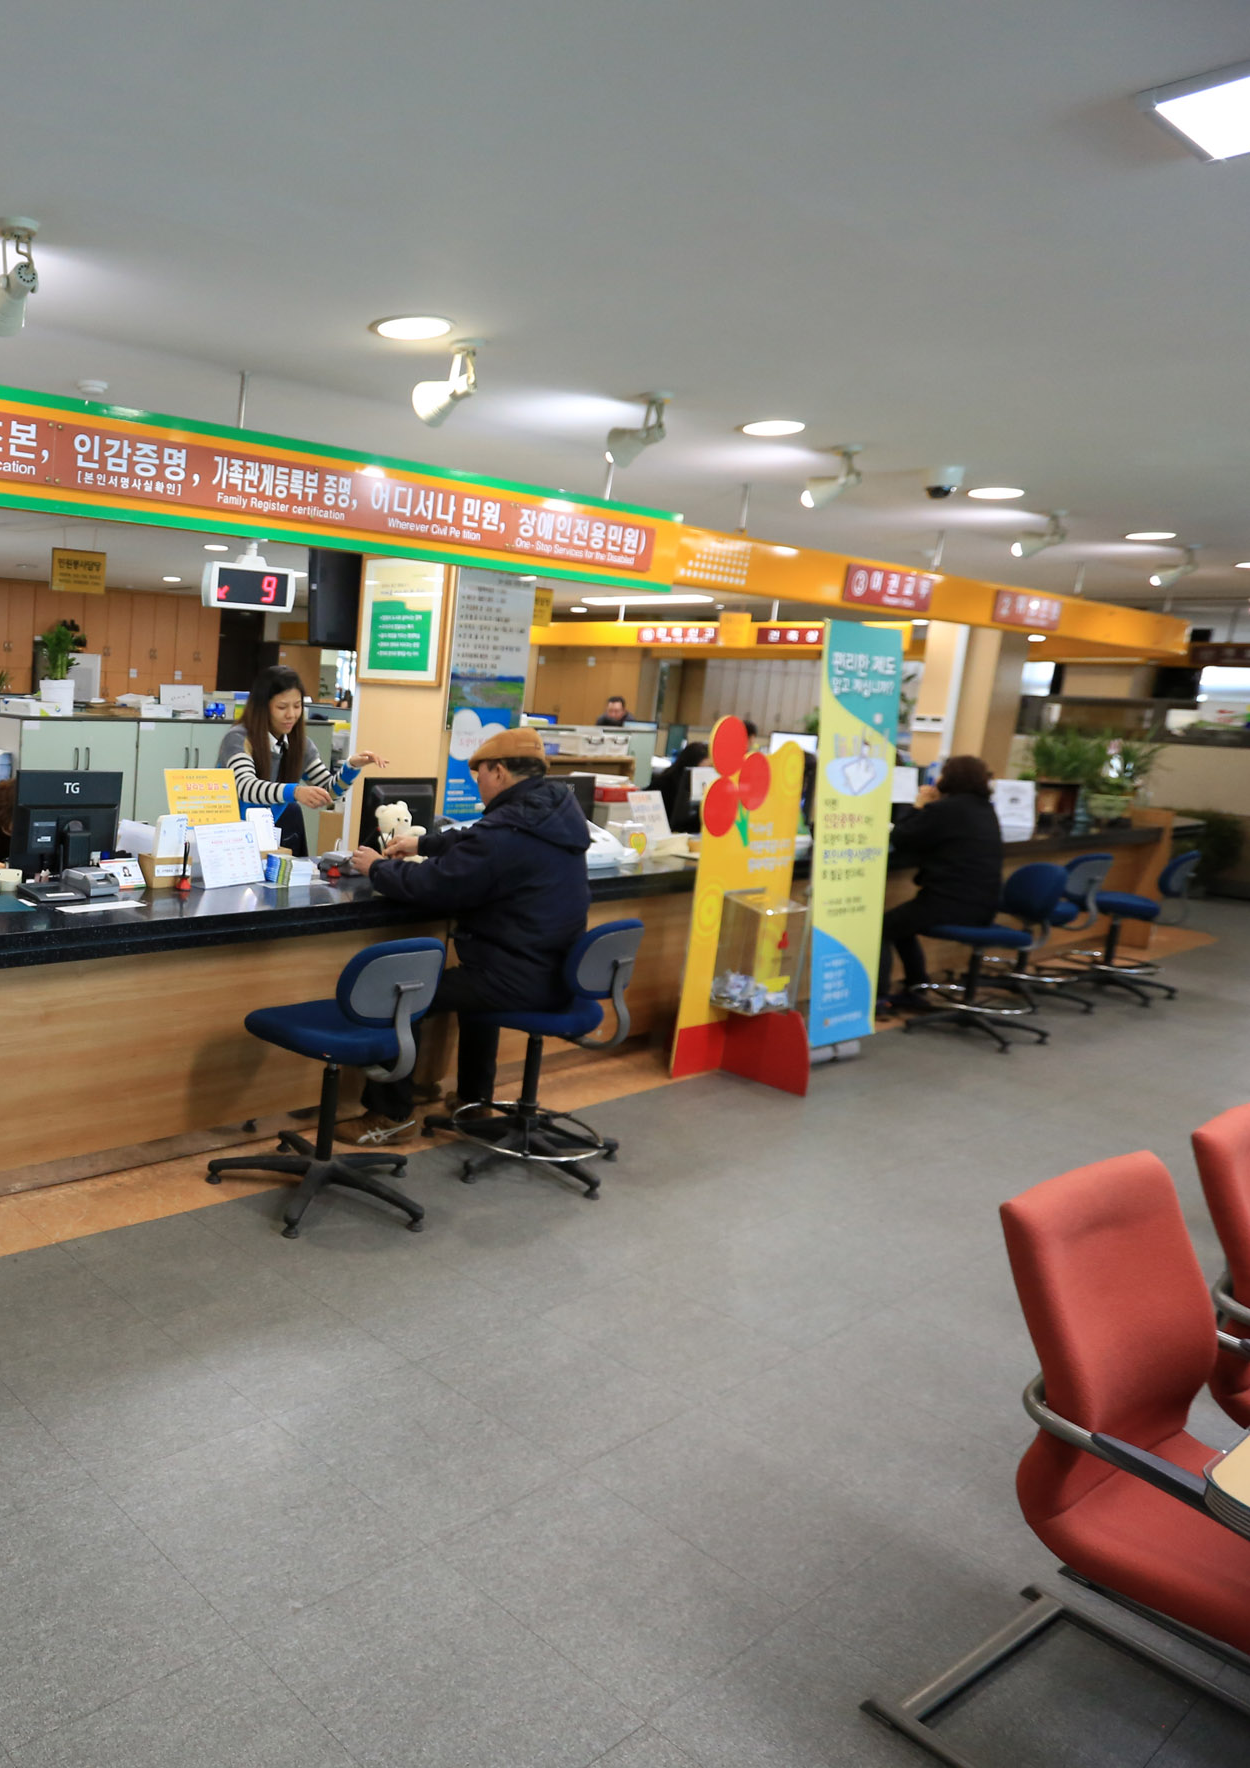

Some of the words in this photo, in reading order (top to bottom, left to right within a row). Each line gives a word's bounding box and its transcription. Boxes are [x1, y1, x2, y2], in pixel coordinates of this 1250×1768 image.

[73, 433, 200, 487] 인감증명,
[212, 454, 319, 503] 가족관계등록부
[323, 473, 358, 510] 증명,
[371, 481, 456, 524] 어디서나
[462, 497, 505, 534] 민원,
[518, 508, 646, 555] 장애인전용민원)
[217, 492, 247, 509] Family
[250, 497, 289, 514] Register
[292, 504, 345, 520] certification
[388, 517, 429, 533] Wherever
[431, 523, 448, 536] Civil
[554, 544, 583, 557] Services
[585, 548, 594, 559] for
[595, 550, 606, 561] the
[607, 552, 635, 566] Disabled
[260, 575, 278, 603] 9
[64, 782, 80, 794] TG
